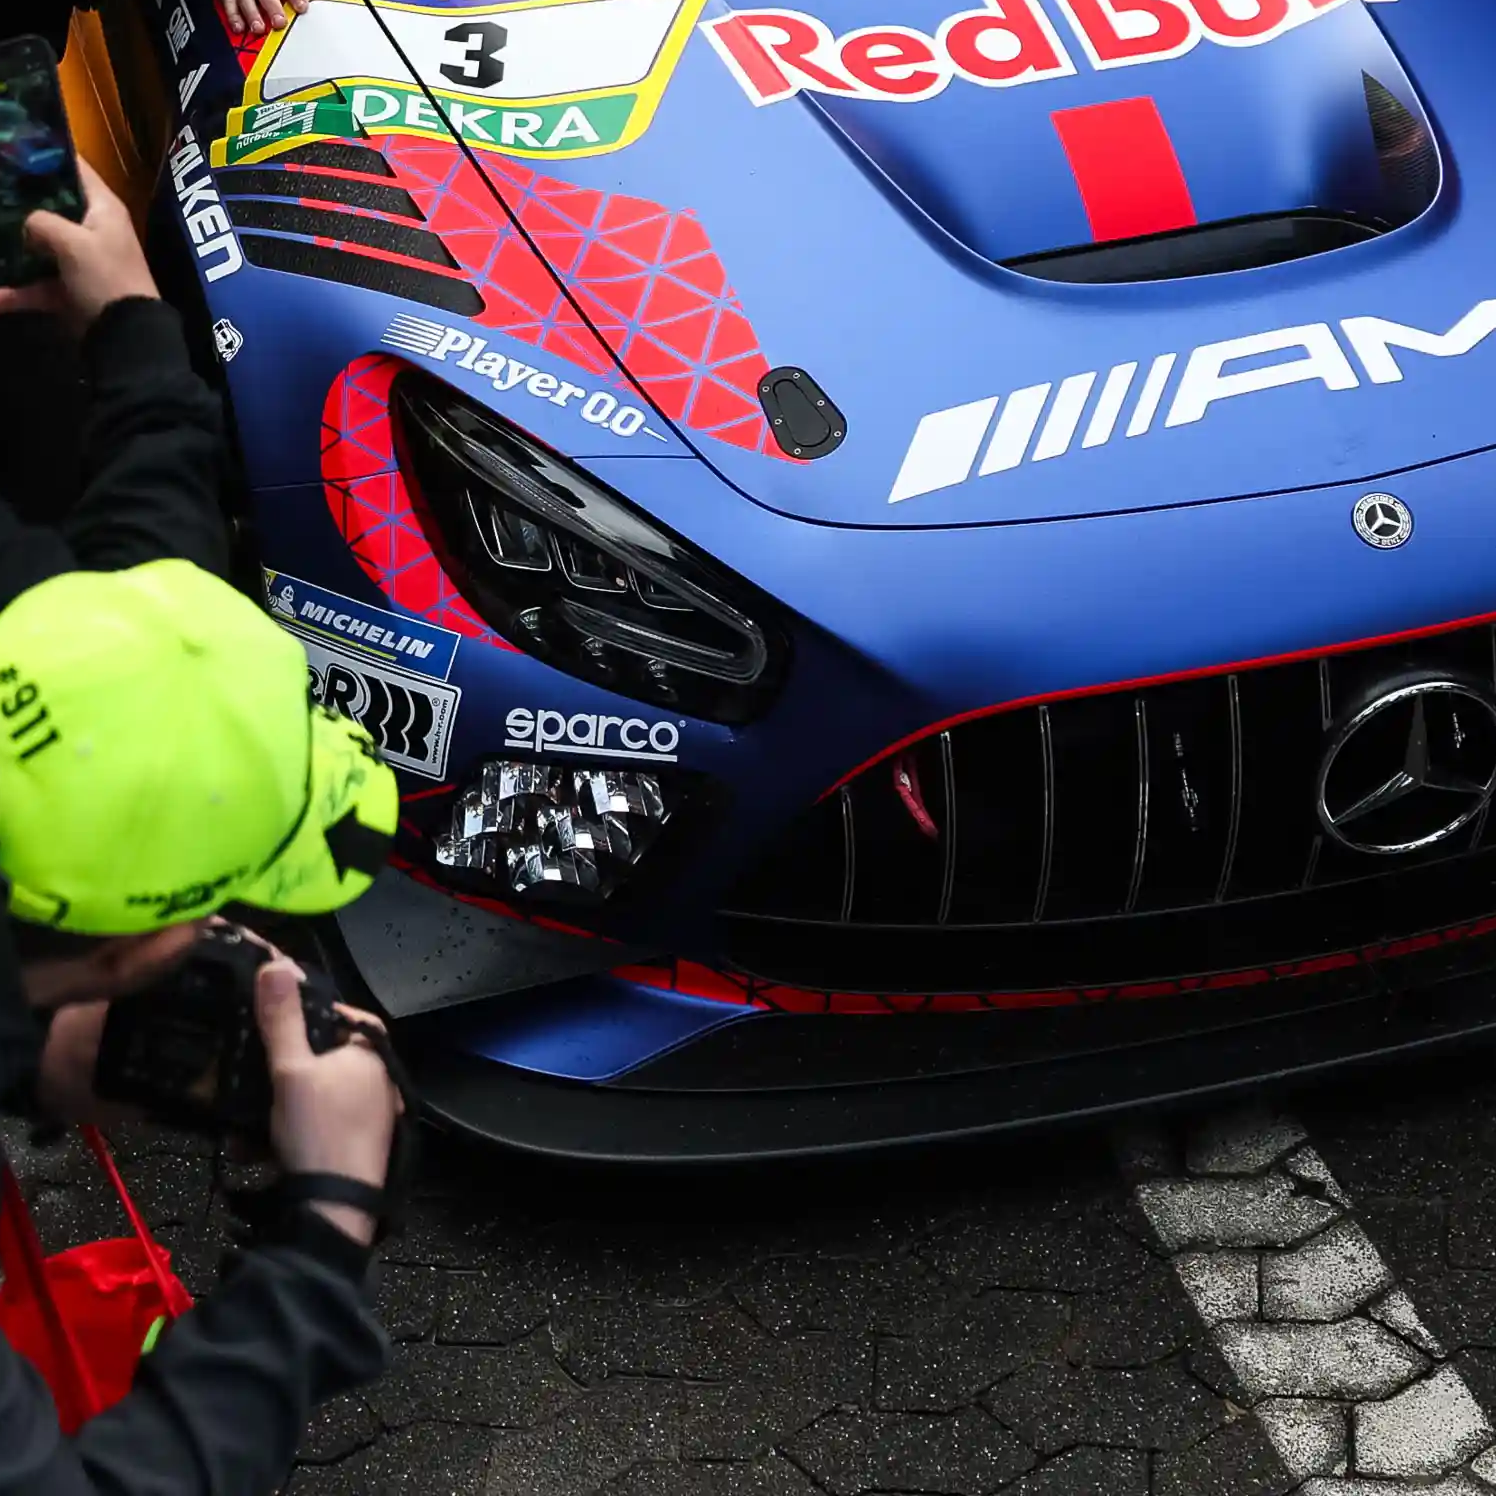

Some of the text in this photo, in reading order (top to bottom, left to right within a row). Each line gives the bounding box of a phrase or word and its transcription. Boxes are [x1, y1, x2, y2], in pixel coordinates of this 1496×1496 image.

[168, 6, 191, 53] OMP
[440, 21, 508, 89] 3
[352, 87, 601, 149] DEKRA
[168, 123, 243, 284] FALKEN
[428, 325, 646, 438] Player 0.0
[301, 601, 435, 660] MICHELIN
[432, 698, 449, 764] www.h-r.com
[505, 706, 680, 754] sparco
